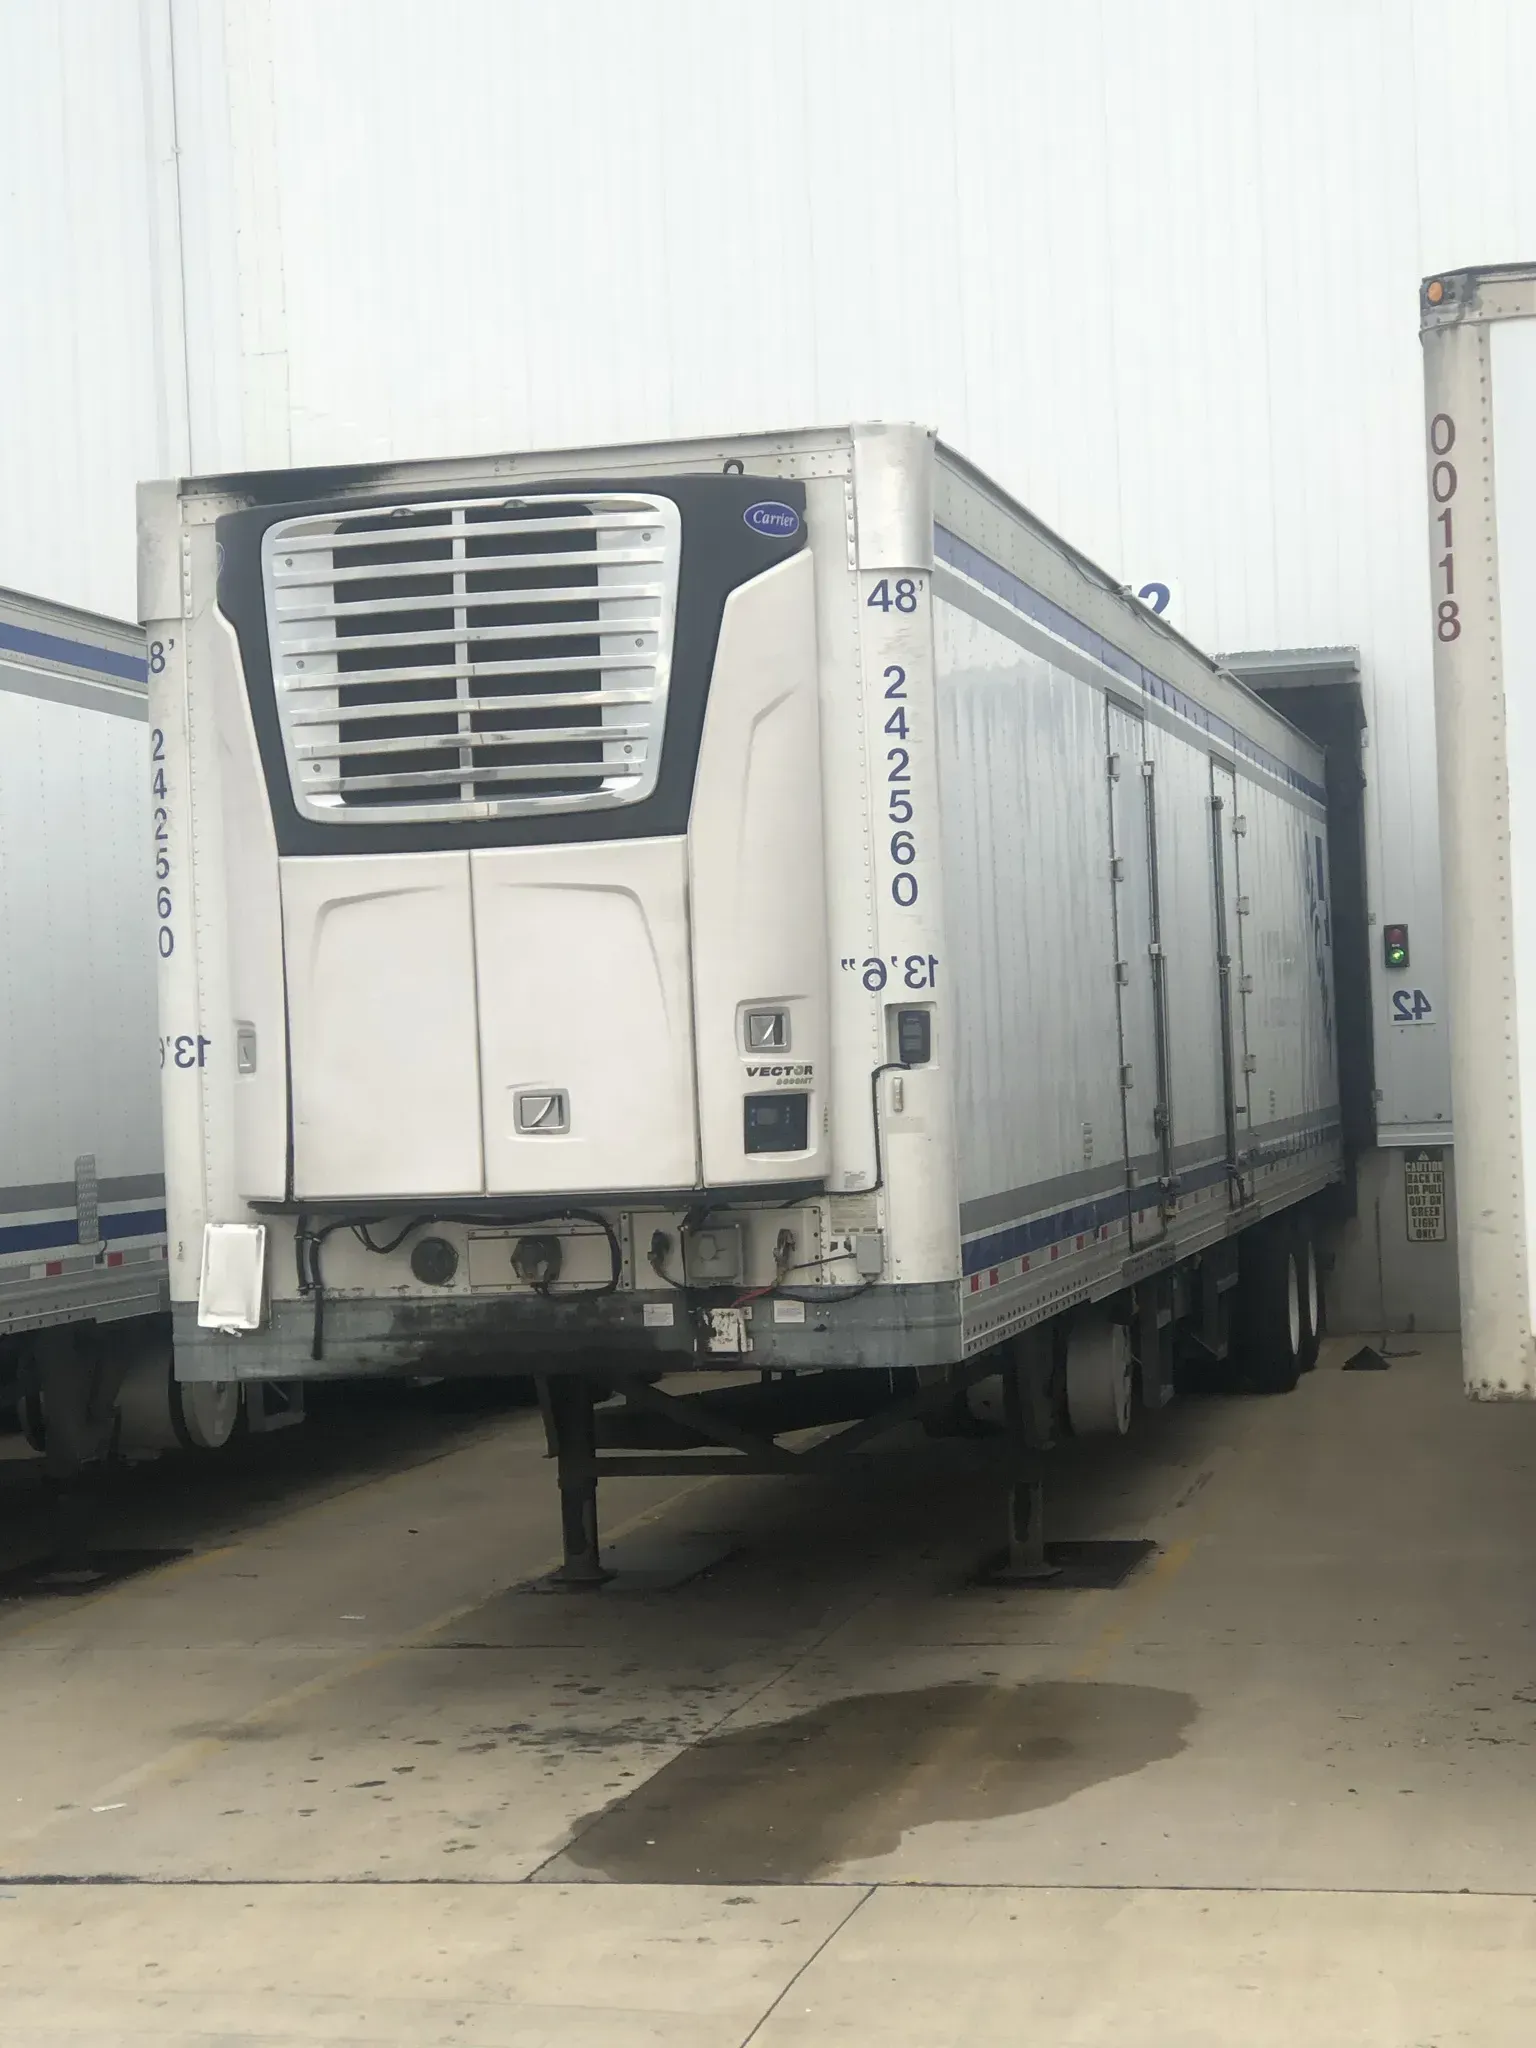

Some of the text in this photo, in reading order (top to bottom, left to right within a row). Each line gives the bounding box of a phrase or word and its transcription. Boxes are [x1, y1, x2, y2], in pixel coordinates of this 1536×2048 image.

[752, 510, 795, 527] Carrier
[1430, 413, 1461, 643] 00118
[866, 578, 925, 614] 48'
[883, 665, 920, 908] 242560
[151, 728, 175, 959] 242560
[746, 1065, 813, 1077] VECTOR
[1405, 1161, 1444, 1172] CAUTION
[1407, 1173, 1442, 1184] BACK IN
[1407, 1184, 1443, 1195] OR PULL
[1409, 1195, 1442, 1206] OUT ON
[1411, 1206, 1440, 1217] GREEN
[1412, 1217, 1440, 1228] LIGHT
[1416, 1228, 1437, 1239] ONLY
